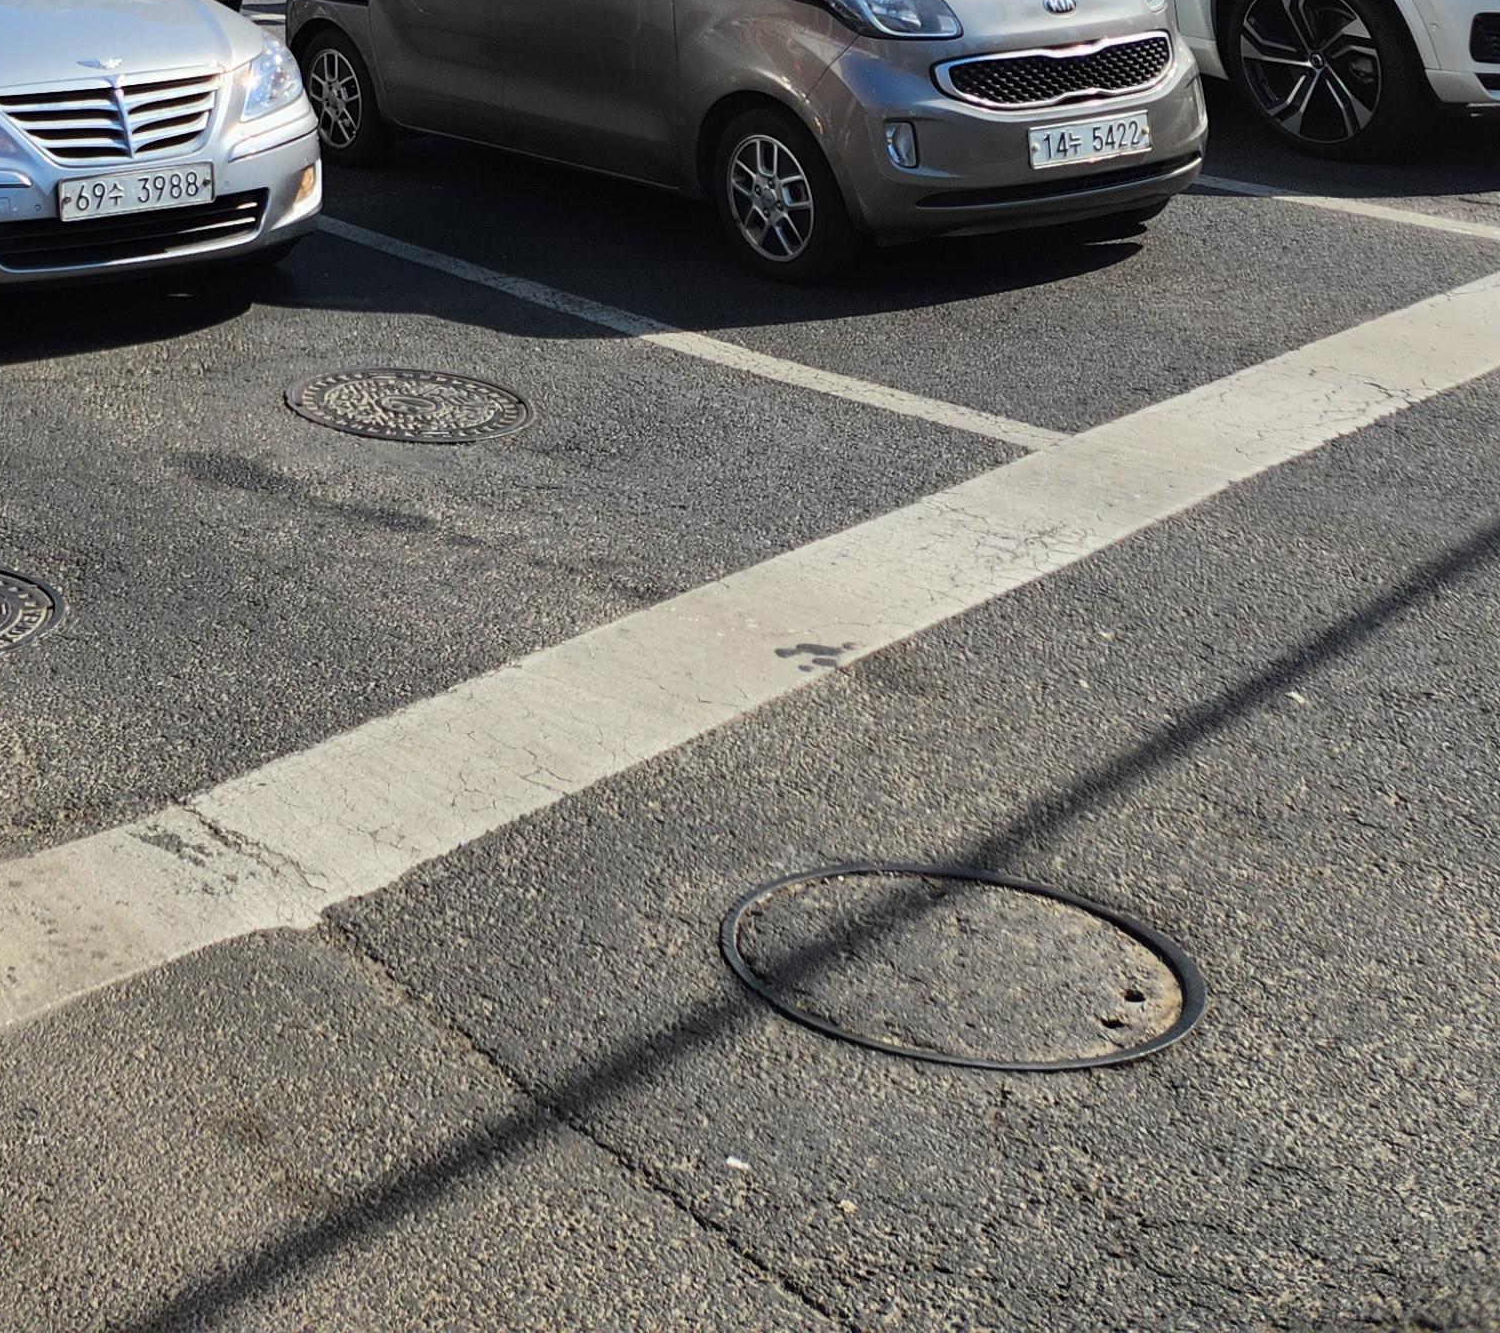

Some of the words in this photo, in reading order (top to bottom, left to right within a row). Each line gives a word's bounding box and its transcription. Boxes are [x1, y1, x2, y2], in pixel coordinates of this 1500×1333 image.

[1091, 121, 1140, 152] 5422
[75, 181, 126, 213] 69수
[136, 170, 200, 204] 3988
